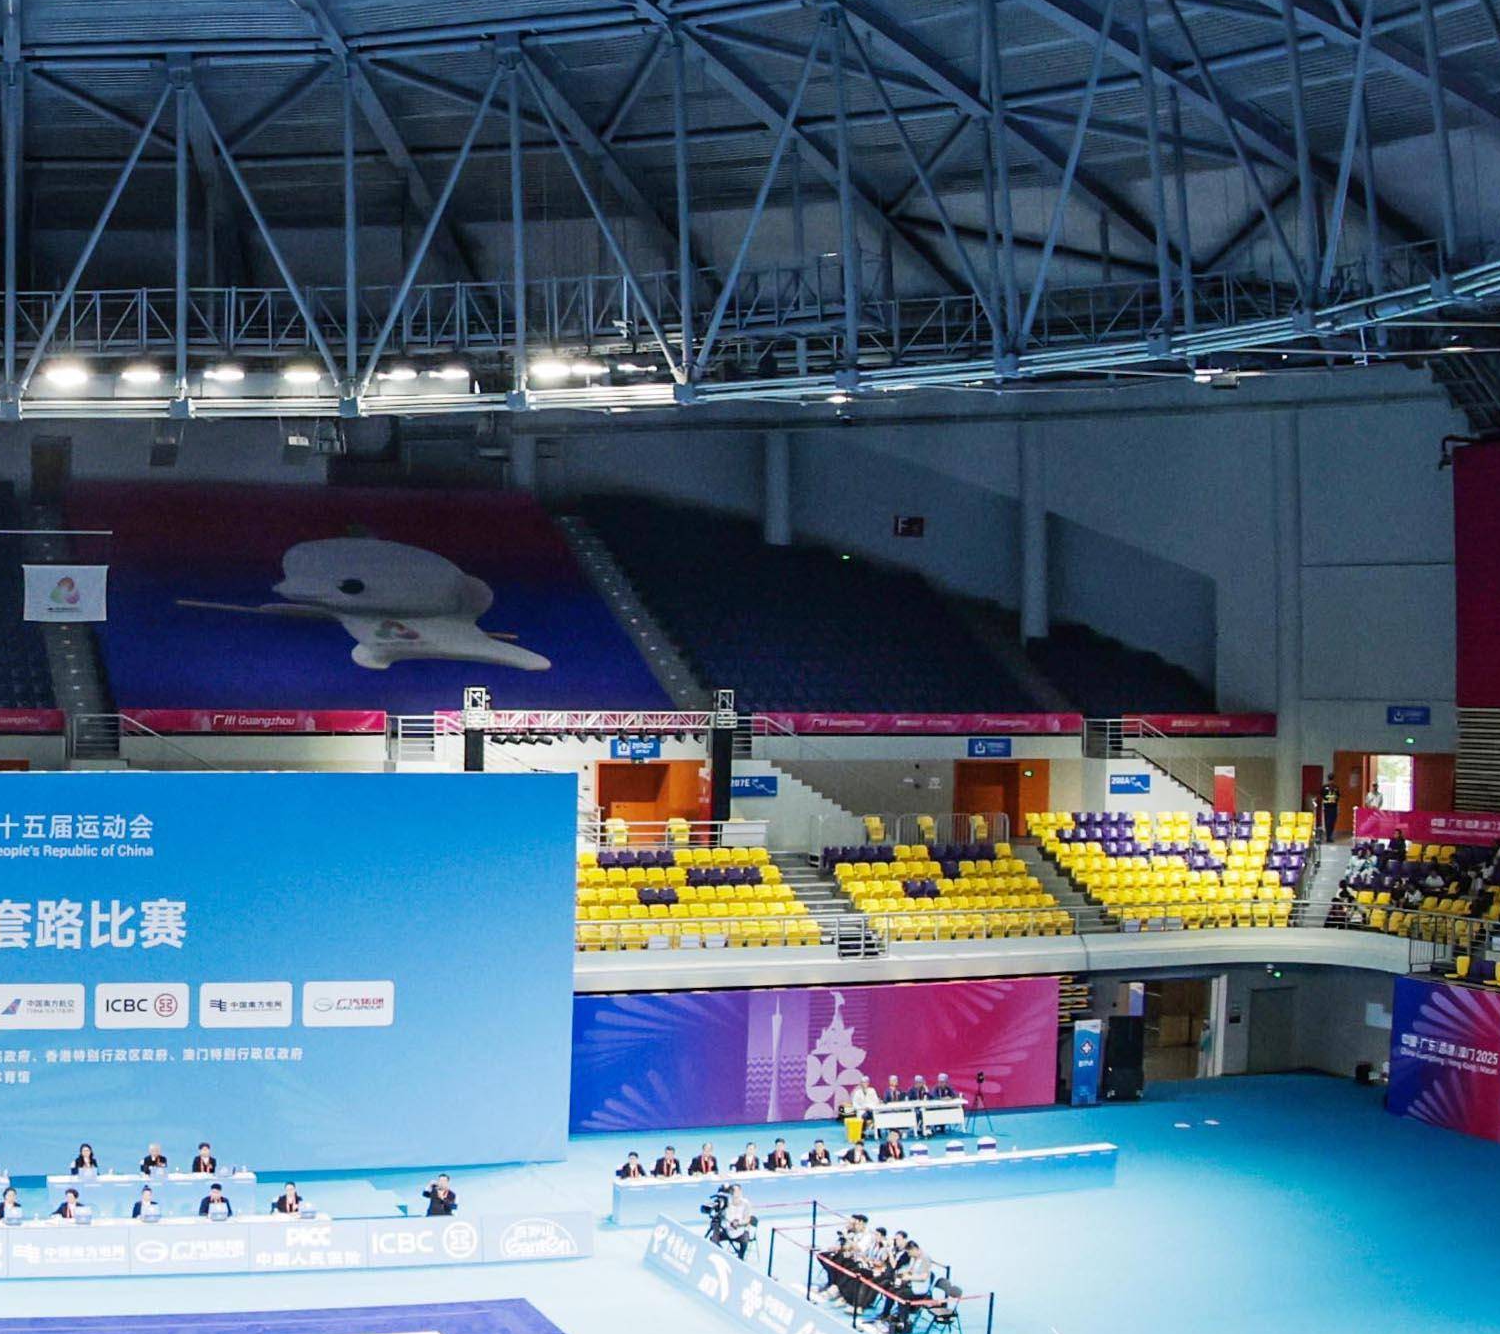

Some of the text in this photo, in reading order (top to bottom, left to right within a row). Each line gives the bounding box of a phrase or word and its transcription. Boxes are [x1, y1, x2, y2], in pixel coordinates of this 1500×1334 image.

[238, 715, 295, 727] Guangzhou
[43, 844, 97, 860] Republic
[101, 844, 115, 859] of
[118, 844, 154, 859] China
[105, 998, 149, 1013] ICBC
[1476, 1050, 1499, 1065] 2025
[373, 1231, 434, 1256] ICBC
